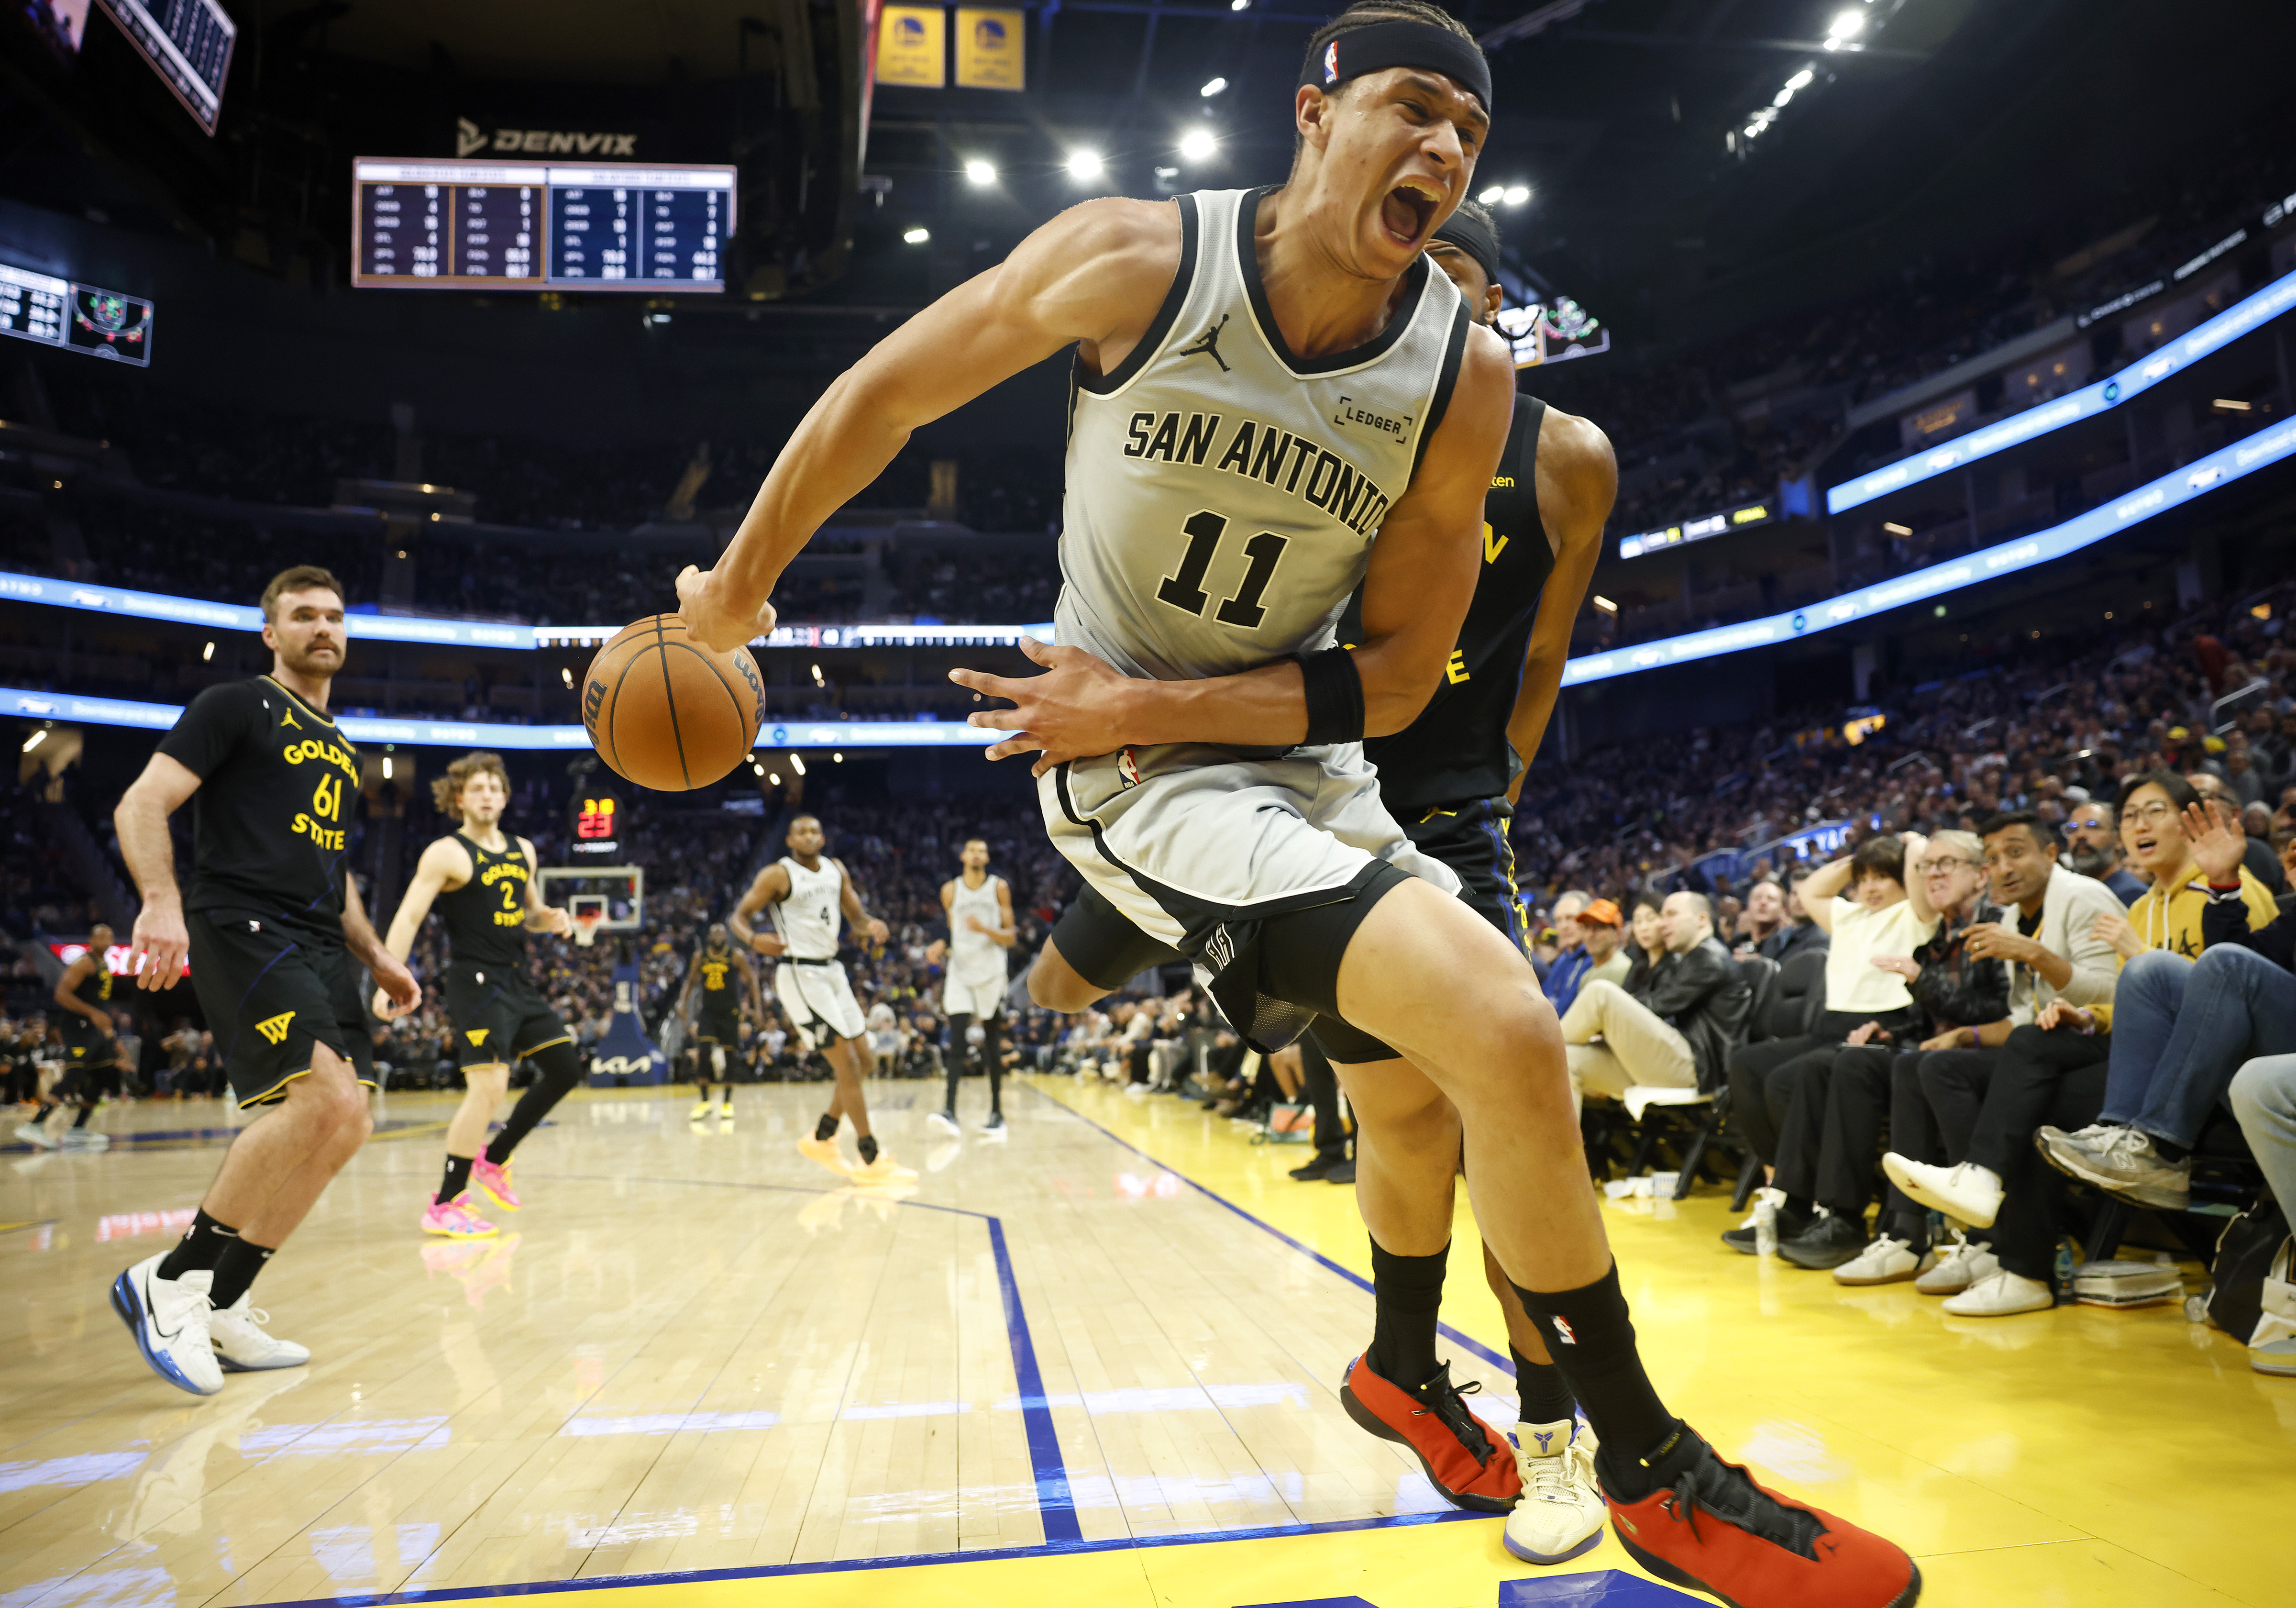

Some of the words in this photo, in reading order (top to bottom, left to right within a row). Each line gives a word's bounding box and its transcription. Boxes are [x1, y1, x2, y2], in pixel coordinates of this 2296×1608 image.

[492, 128, 638, 156] DENVIX
[1346, 407, 1402, 434] LEDGER
[1122, 410, 1223, 467] SAN
[1214, 418, 1390, 537] ANTONIO
[1154, 508, 1292, 630] 11
[283, 739, 359, 788] GOLDEN
[313, 772, 342, 822] 61
[1124, 781, 1135, 789] NBA
[291, 812, 345, 851] STATE
[578, 811, 613, 838] 23
[481, 863, 529, 886] GOLDEN
[499, 881, 517, 909] 2
[821, 907, 830, 926] 4
